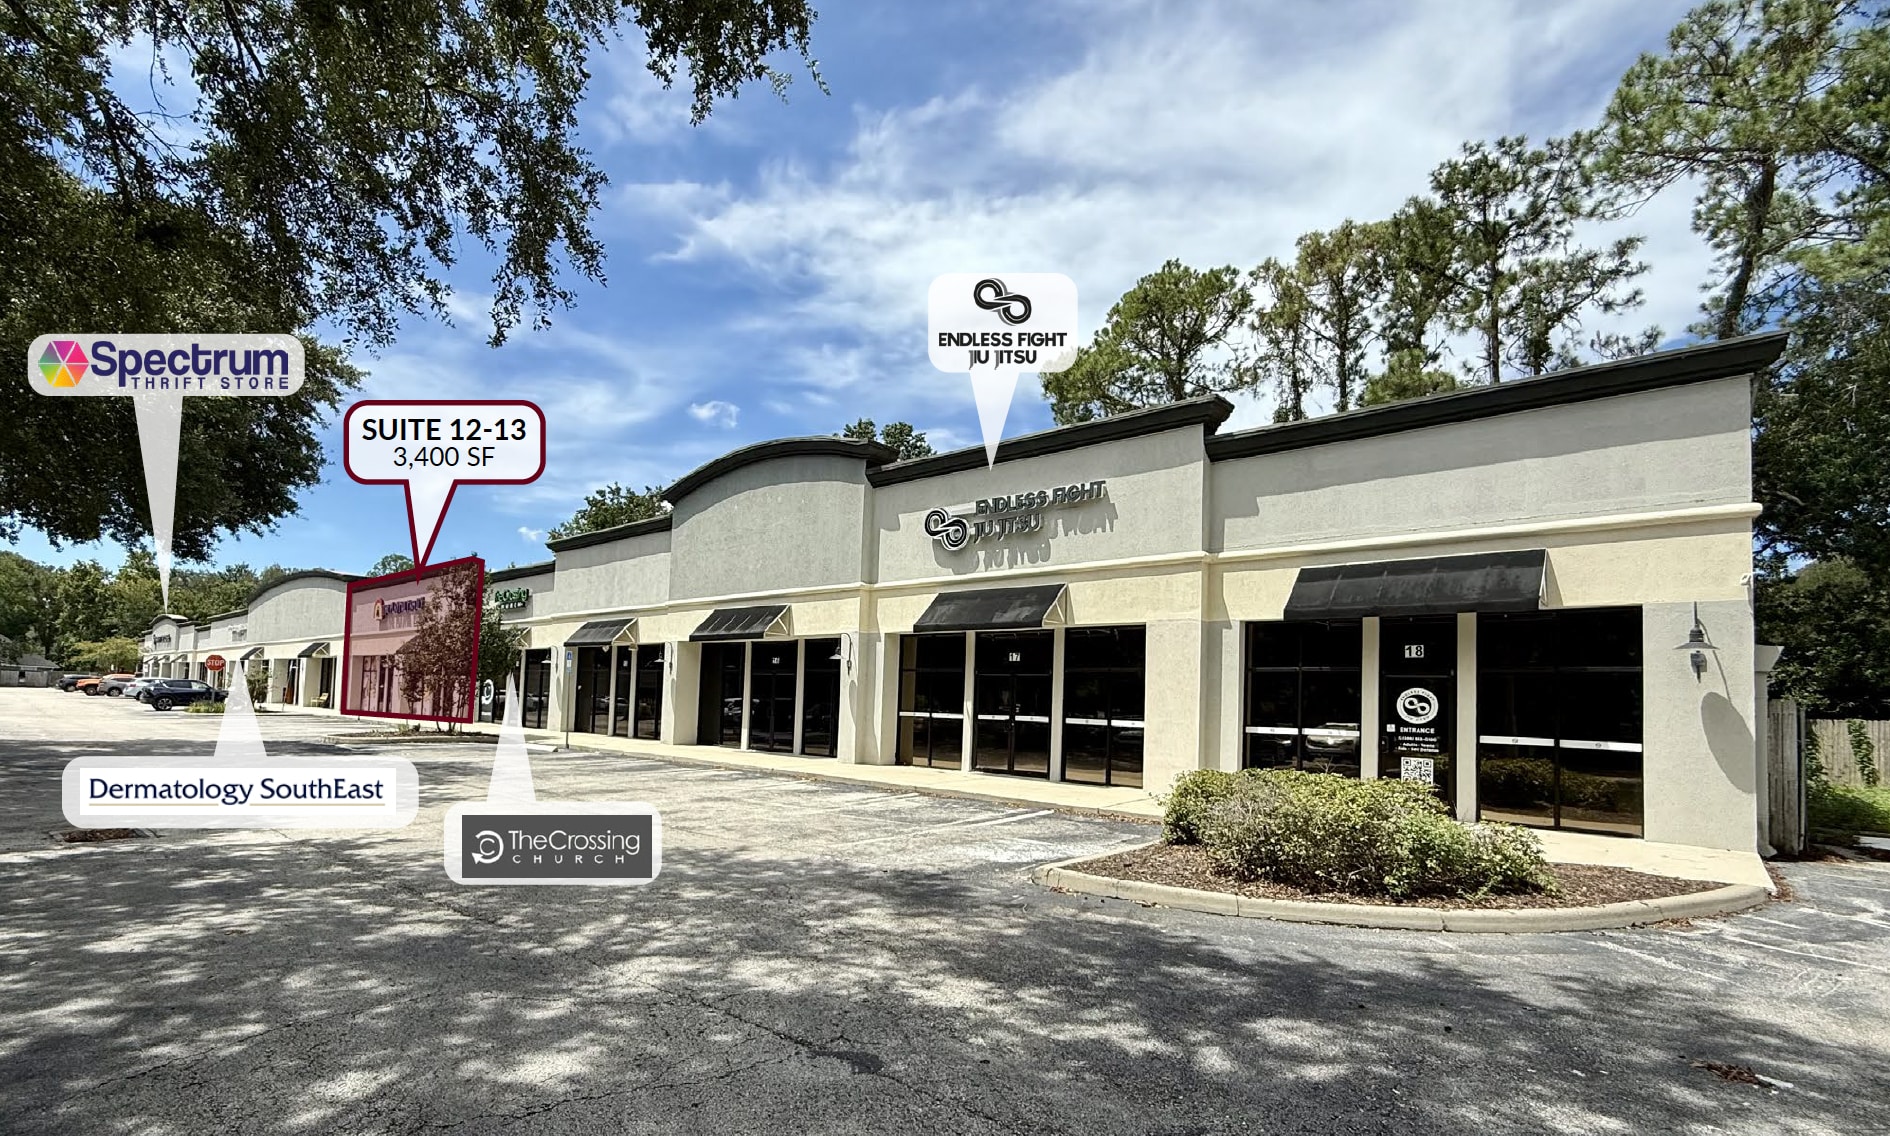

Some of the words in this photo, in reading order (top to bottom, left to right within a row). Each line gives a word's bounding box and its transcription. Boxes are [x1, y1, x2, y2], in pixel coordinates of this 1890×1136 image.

[974, 490, 1049, 516] ENDLESS
[1052, 480, 1106, 505] FIGHT
[973, 520, 993, 543] JIU
[996, 513, 1042, 541] JITSU
[1404, 645, 1423, 657] 18
[207, 659, 225, 667] STOP
[1400, 726, 1435, 734] ENTRANCE
